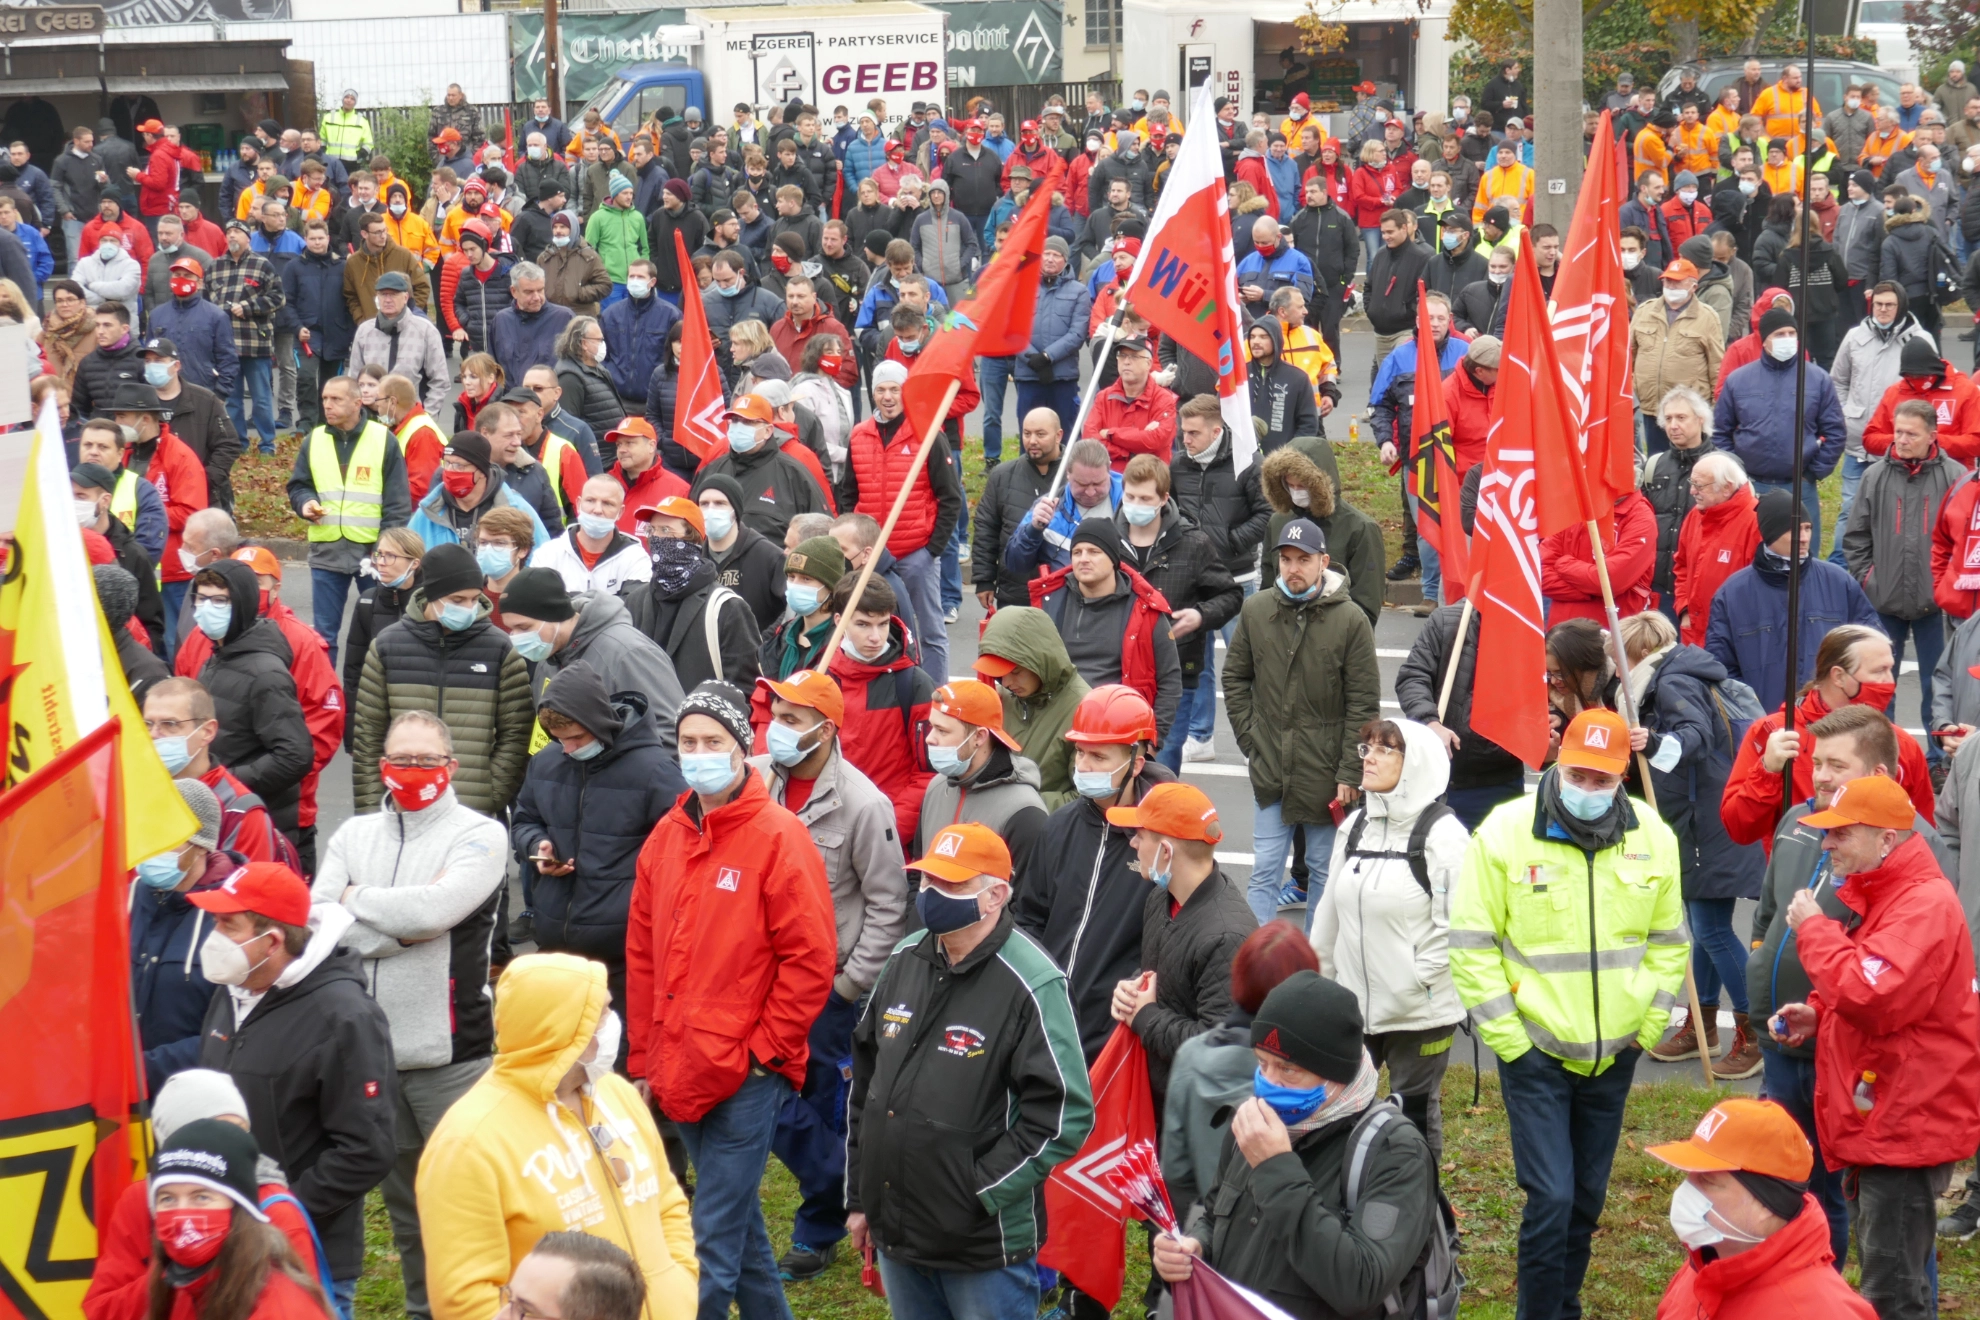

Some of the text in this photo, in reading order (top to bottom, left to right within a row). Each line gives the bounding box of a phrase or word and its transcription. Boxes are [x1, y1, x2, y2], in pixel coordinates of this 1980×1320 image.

[35, 12, 95, 33] GEEB
[828, 33, 939, 48] PARTYSERVICE
[1024, 37, 1043, 70] 7
[822, 61, 938, 95] GEEB
[1550, 182, 1564, 191] 47
